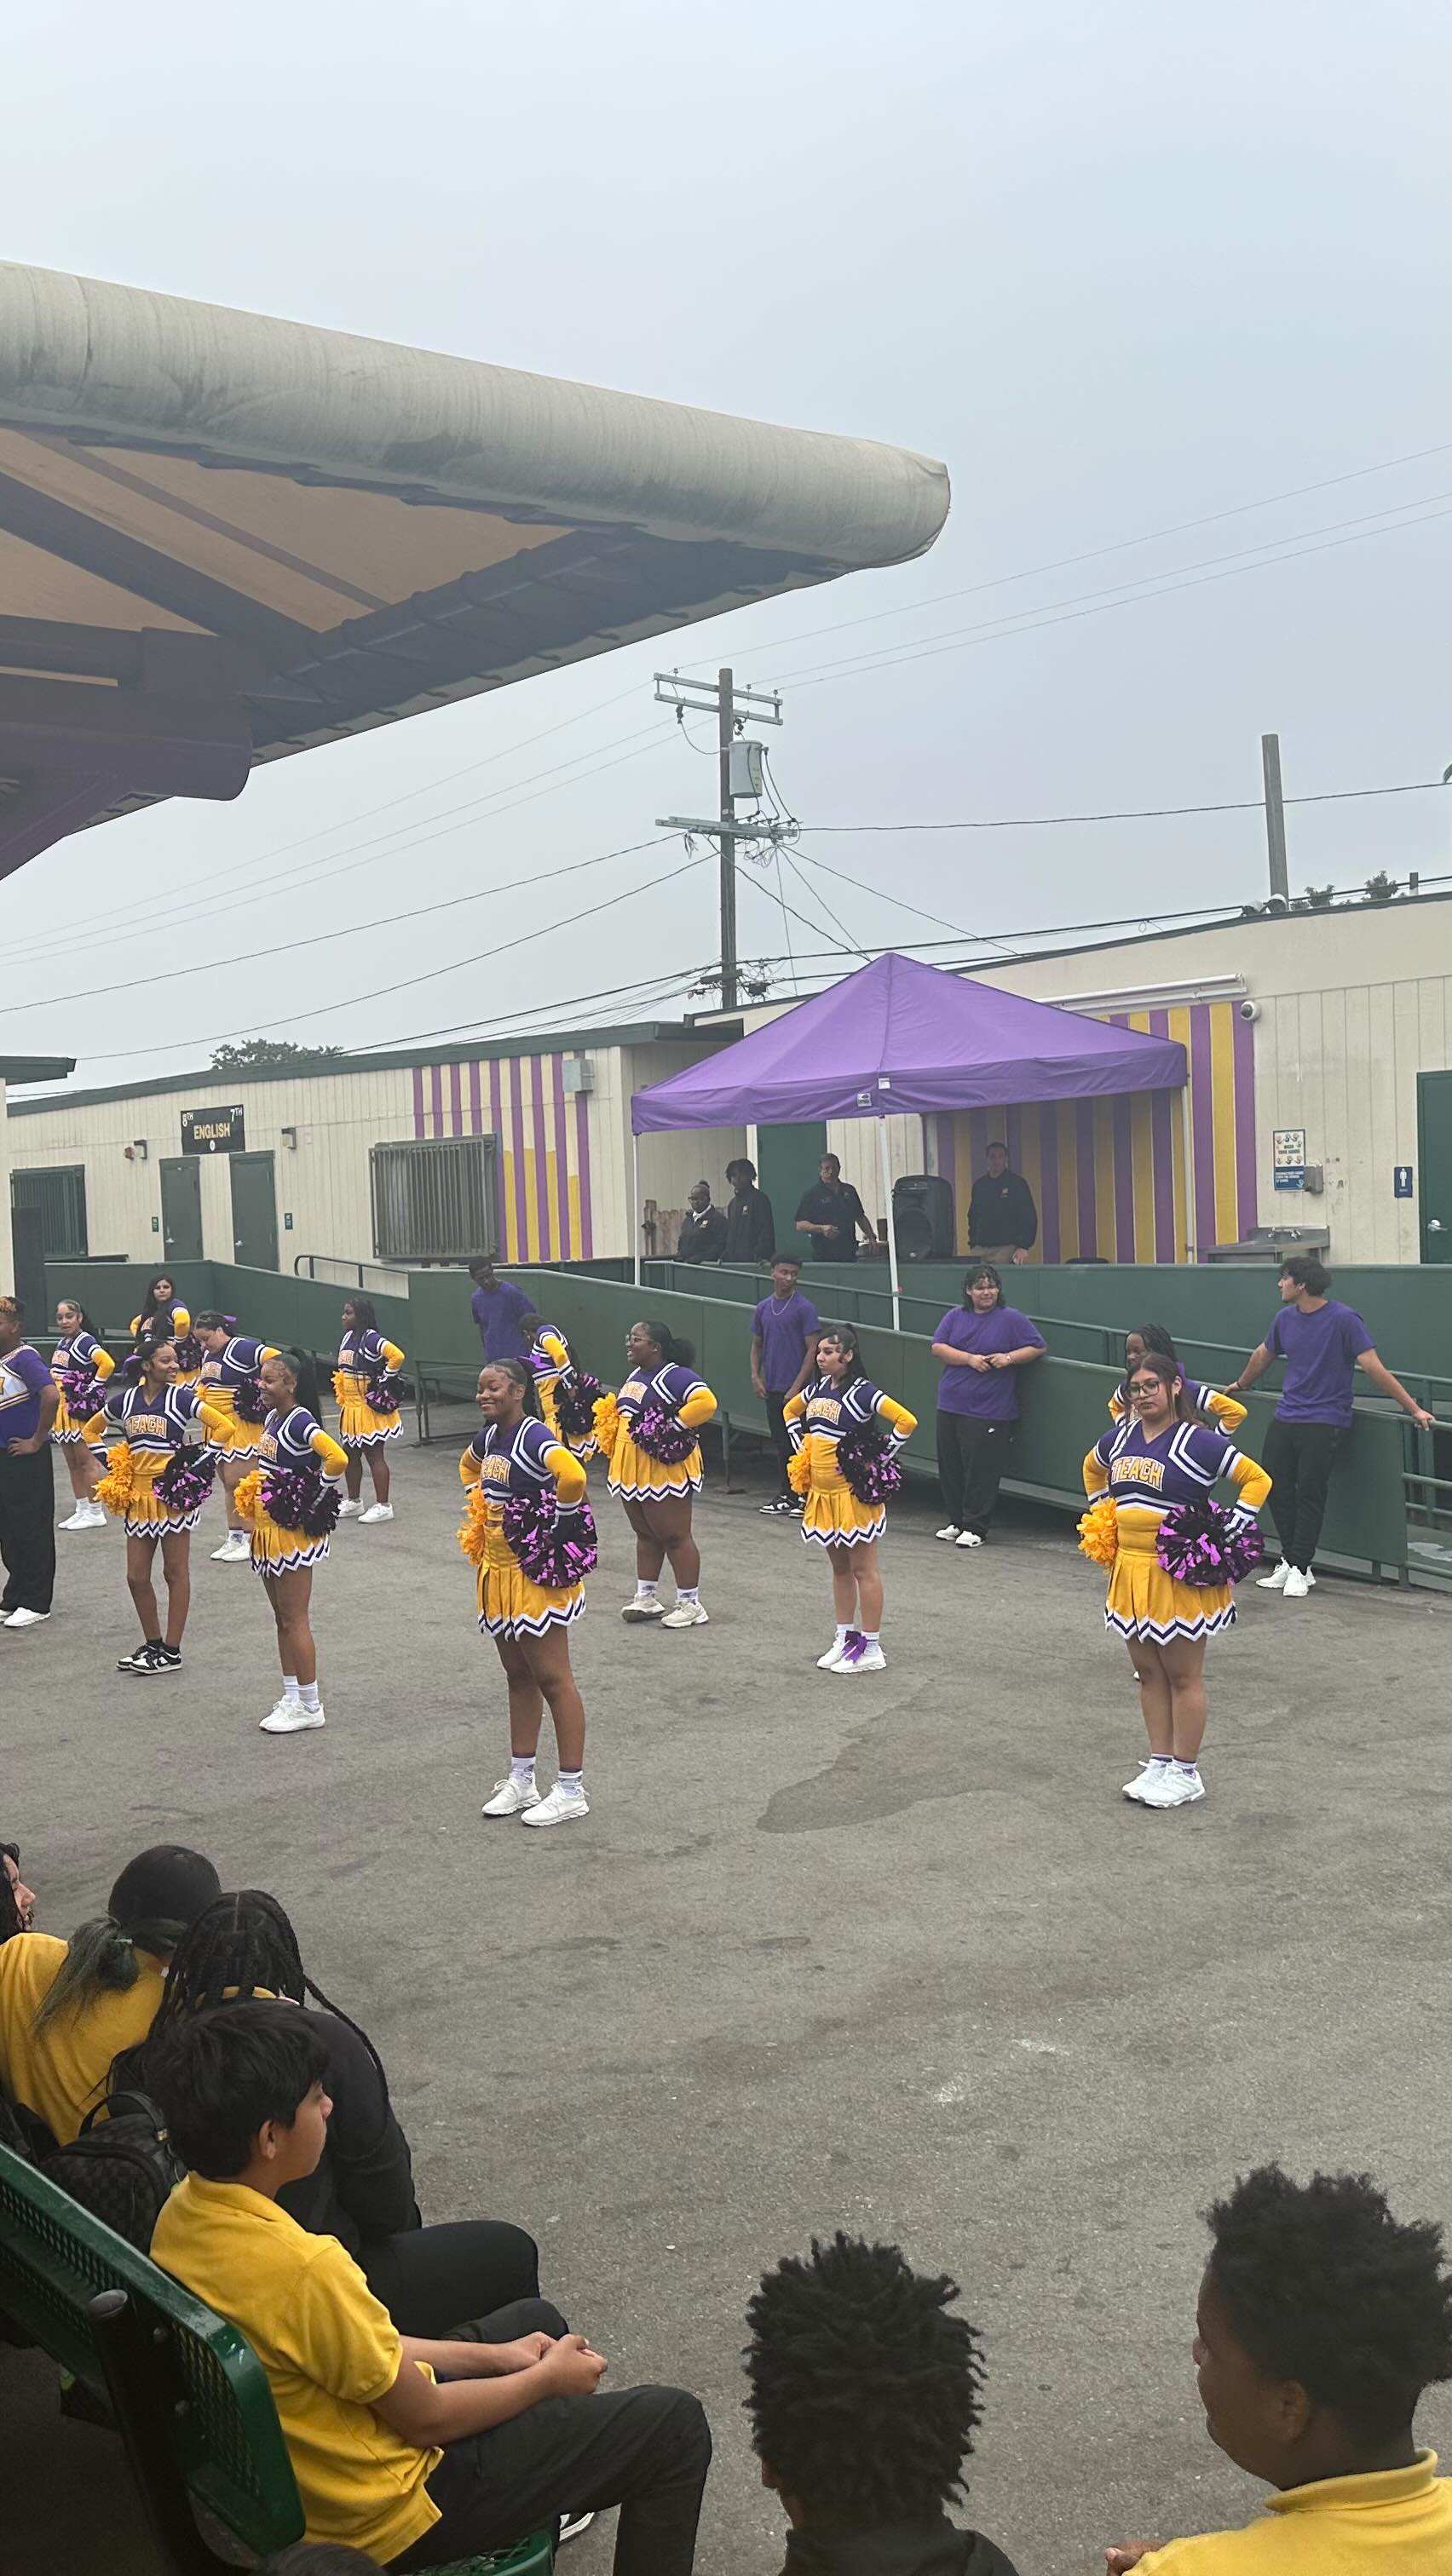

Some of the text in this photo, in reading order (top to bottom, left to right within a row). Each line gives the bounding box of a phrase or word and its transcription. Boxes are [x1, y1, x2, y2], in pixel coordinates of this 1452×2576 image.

[230, 1107, 242, 1122] 7TH
[193, 1123, 231, 1140] ENGLISH
[1112, 1456, 1164, 1491] TEACH
